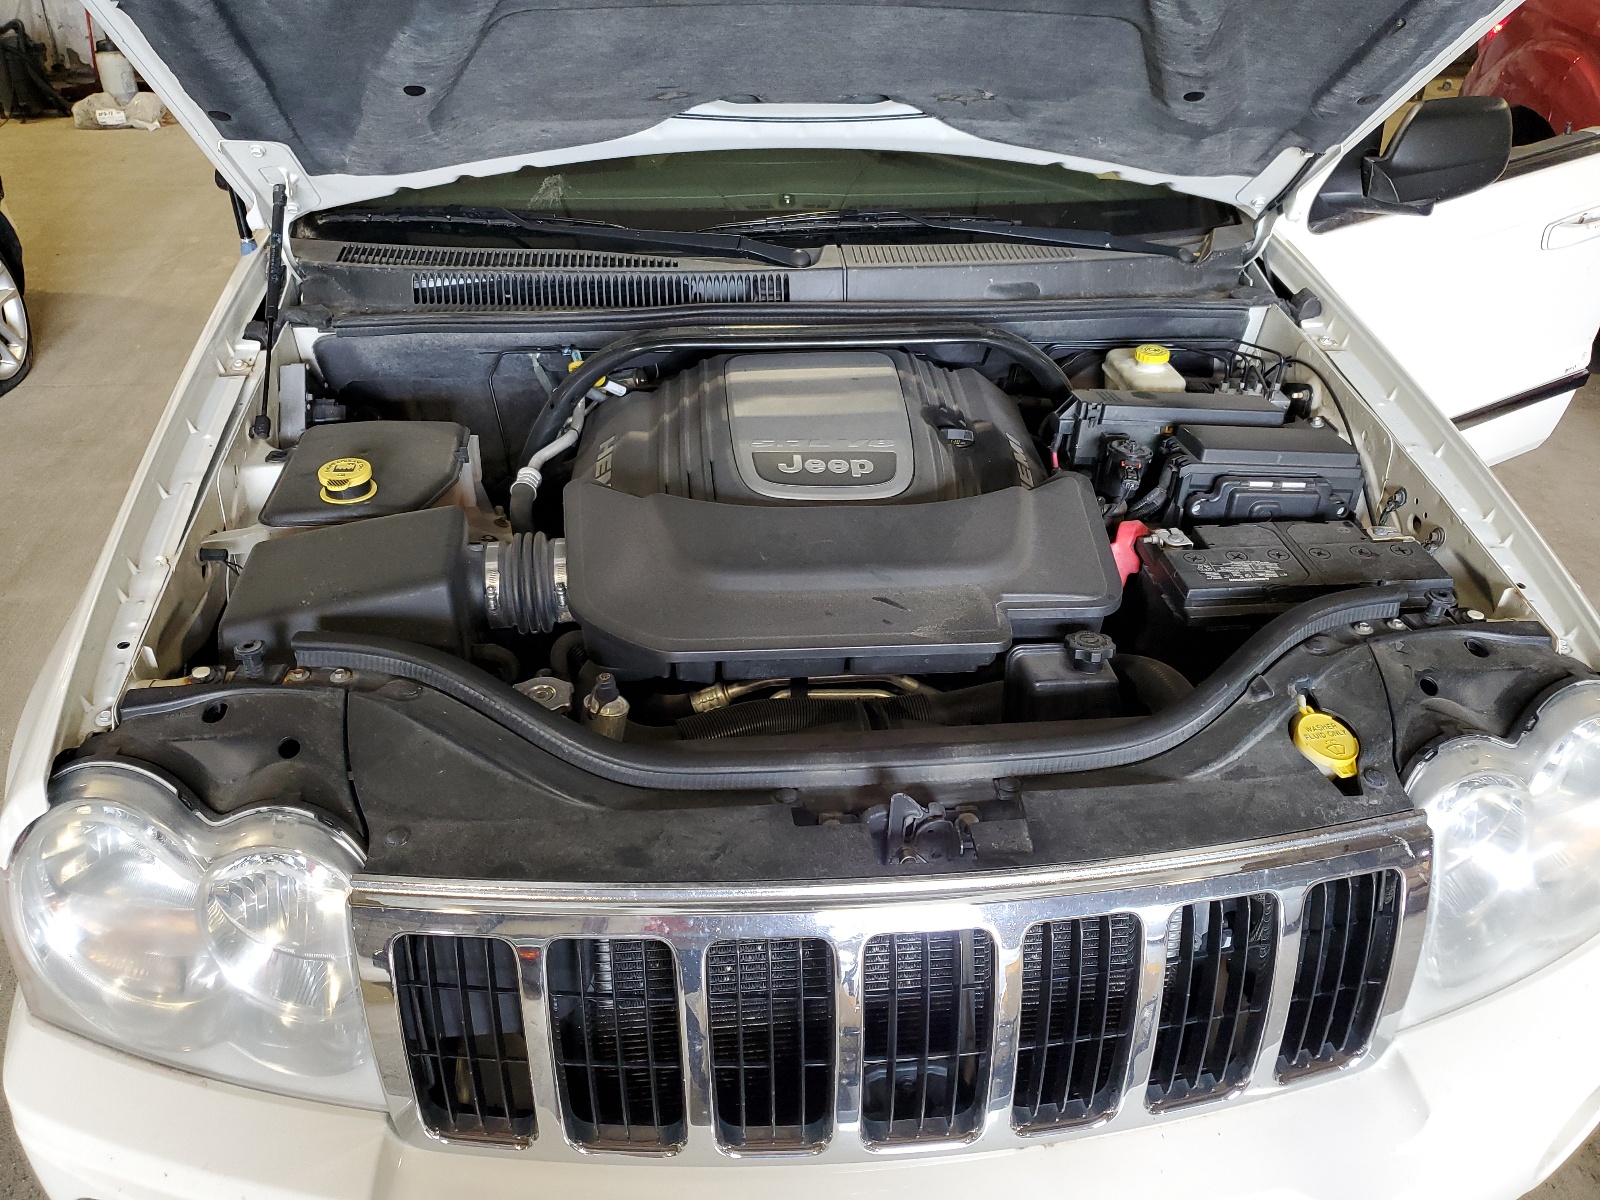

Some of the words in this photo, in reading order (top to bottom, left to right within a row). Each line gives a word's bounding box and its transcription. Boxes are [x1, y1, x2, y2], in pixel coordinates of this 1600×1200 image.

[777, 454, 874, 478] Jeep
[1305, 722, 1337, 732] WASHER
[1304, 732, 1326, 740] FLUID
[1327, 729, 1347, 738] ONLY
